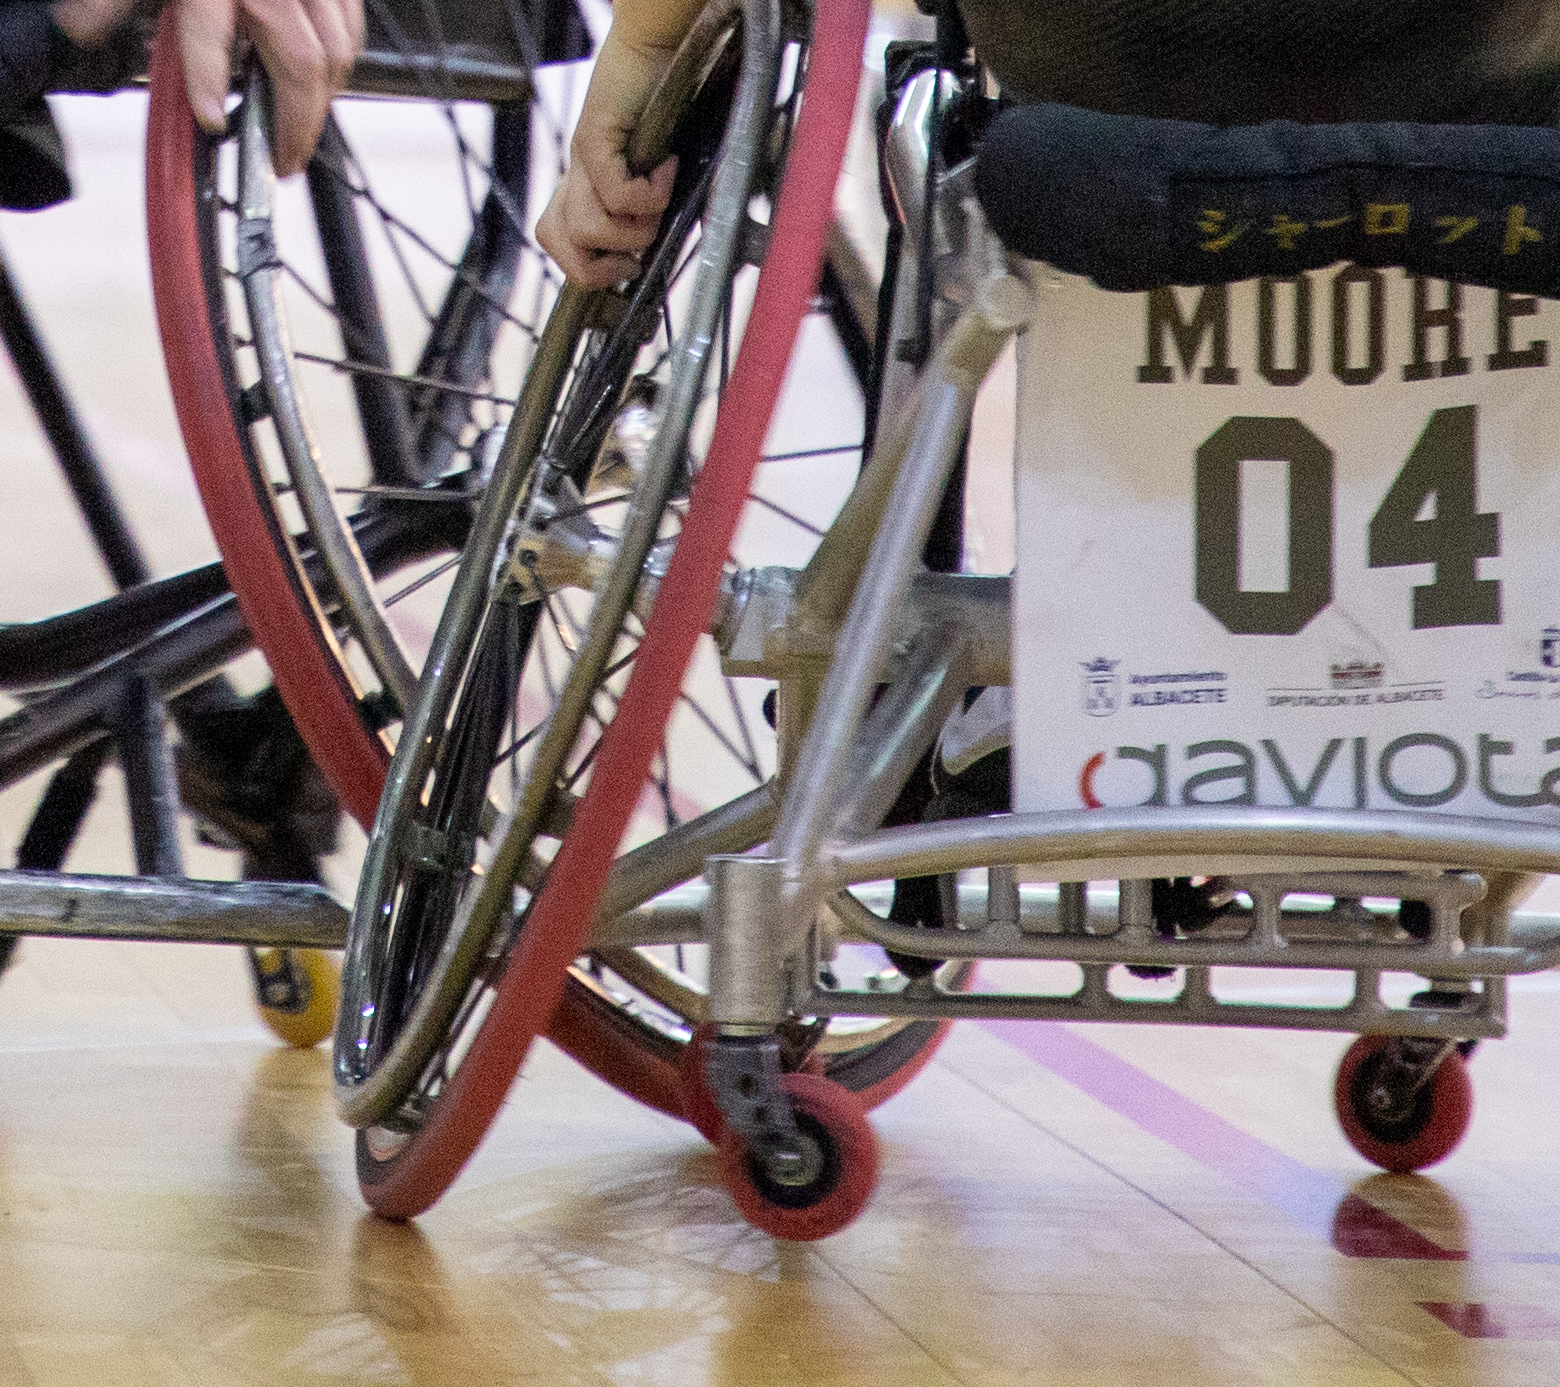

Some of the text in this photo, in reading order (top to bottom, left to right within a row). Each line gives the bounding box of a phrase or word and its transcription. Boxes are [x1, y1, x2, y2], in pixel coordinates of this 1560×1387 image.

[1197, 202, 1544, 255] シャーロット
[1137, 266, 1548, 386] MOORE
[1194, 404, 1503, 635] 04
[1130, 688, 1227, 706] ALBACETE
